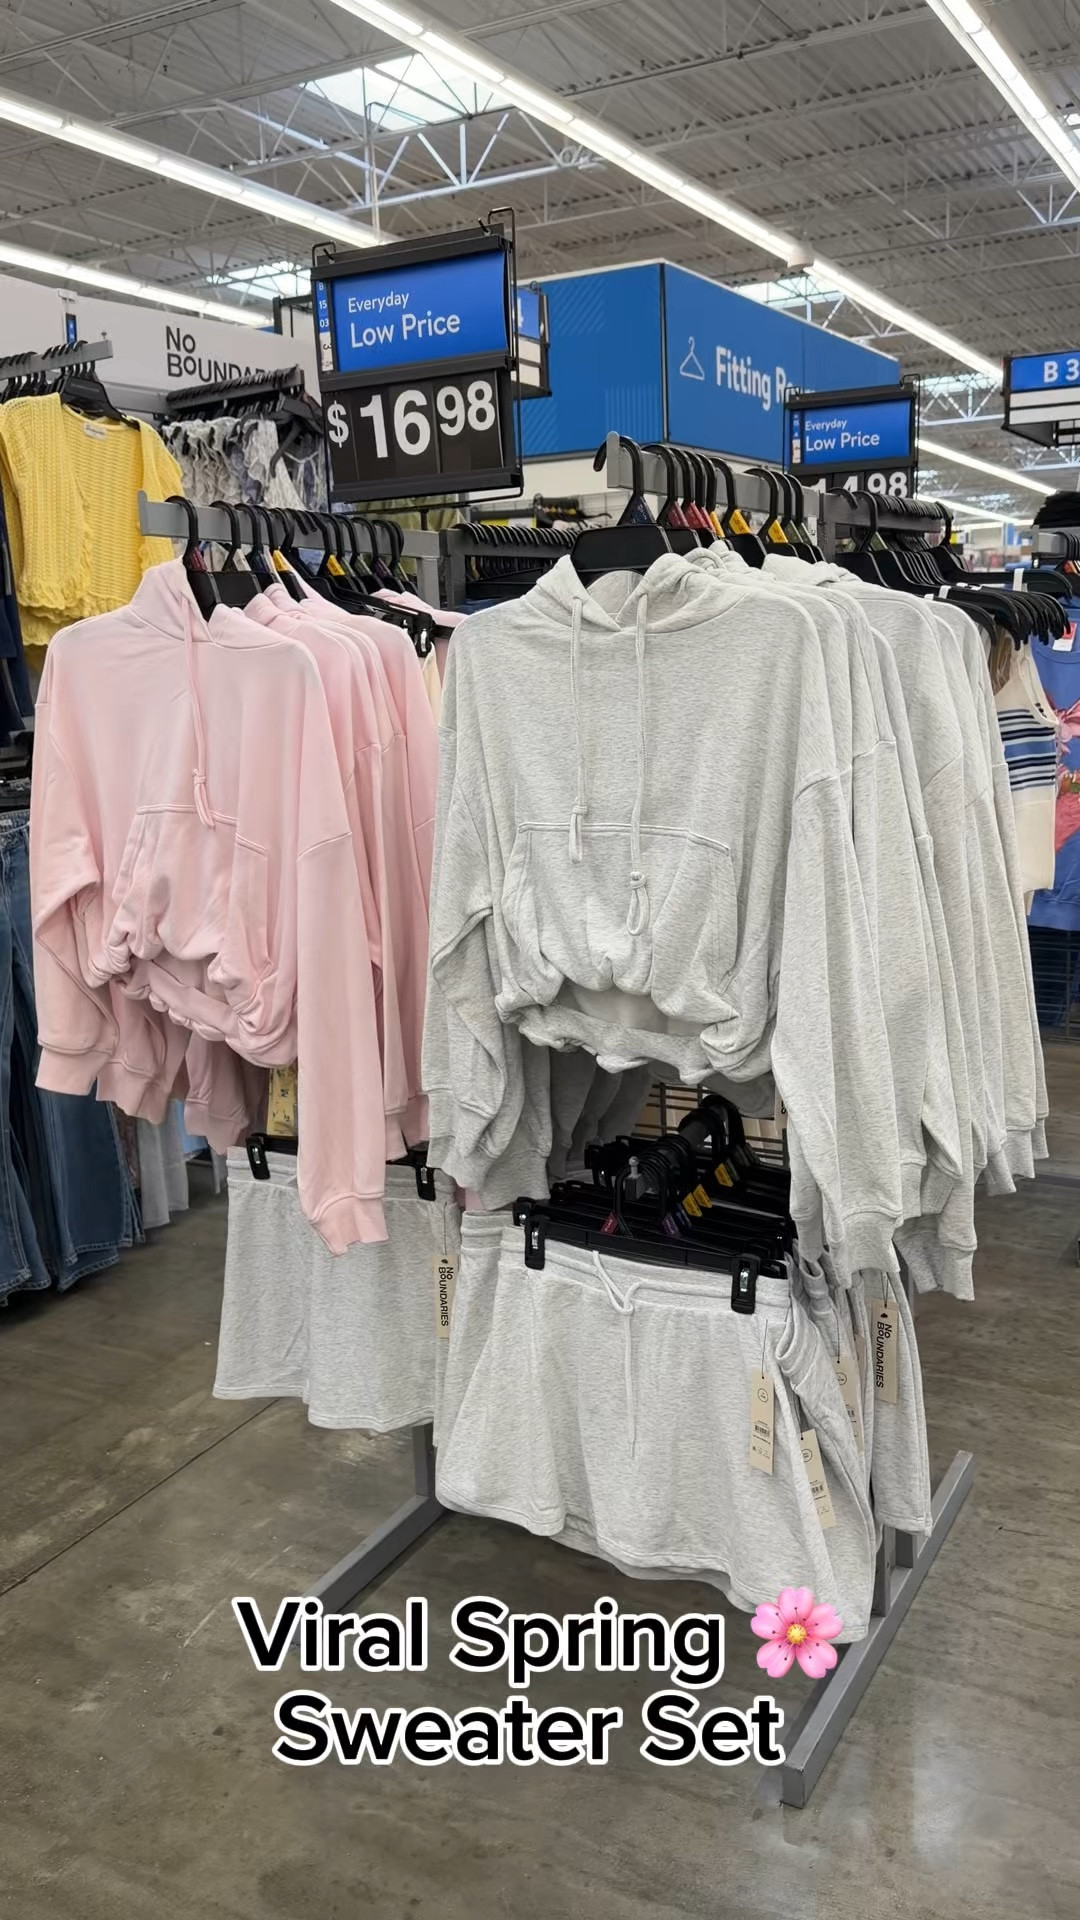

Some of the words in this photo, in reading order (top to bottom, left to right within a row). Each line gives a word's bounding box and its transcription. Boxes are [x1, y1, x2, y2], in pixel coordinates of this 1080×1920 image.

[348, 291, 410, 313] Everyday
[350, 324, 395, 348] Low
[402, 310, 461, 340] Price
[716, 345, 771, 412] Fitting
[1043, 360, 1059, 383] B
[805, 419, 847, 432] Everyday
[805, 435, 836, 452] Low
[840, 431, 880, 448] Price
[439, 1266, 449, 1327] BOUNDARIES
[876, 1321, 885, 1389] BOUNDARIES
